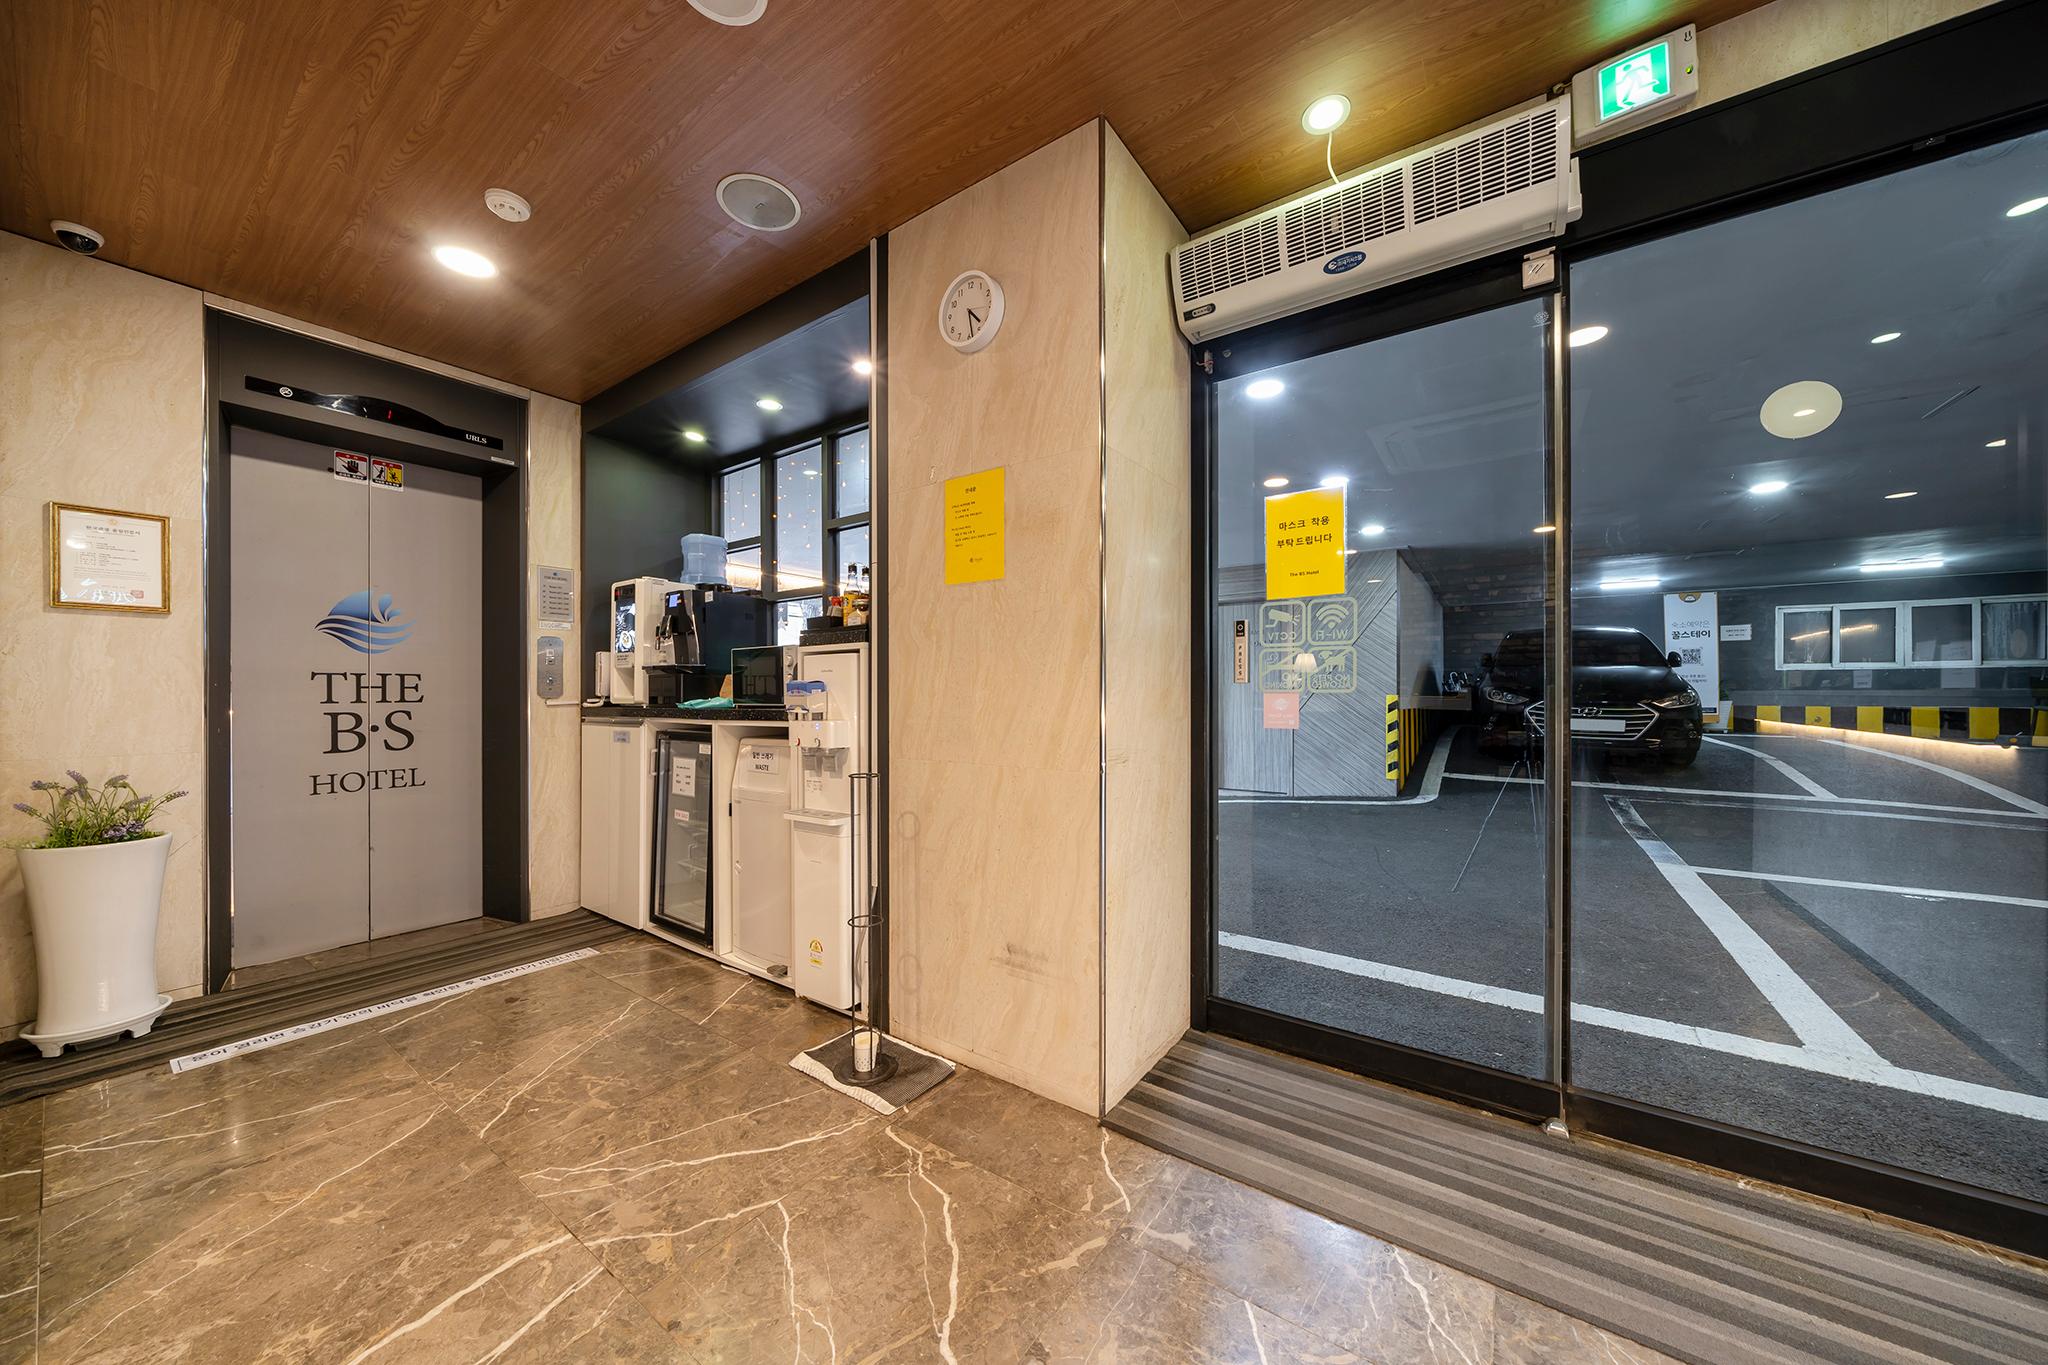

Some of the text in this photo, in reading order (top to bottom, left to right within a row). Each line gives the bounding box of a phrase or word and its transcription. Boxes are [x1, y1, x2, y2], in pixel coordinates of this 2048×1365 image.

[465, 433, 487, 444] URLS
[1279, 515, 1330, 532] 마스크 착용
[1276, 533, 1333, 549] 부탁드립니다
[1672, 630, 1711, 640] 꿀스테이
[310, 671, 424, 704] THE
[309, 768, 426, 796] HOTEL
[192, 1048, 228, 1063] 문이
[234, 1032, 285, 1050] 열리면
